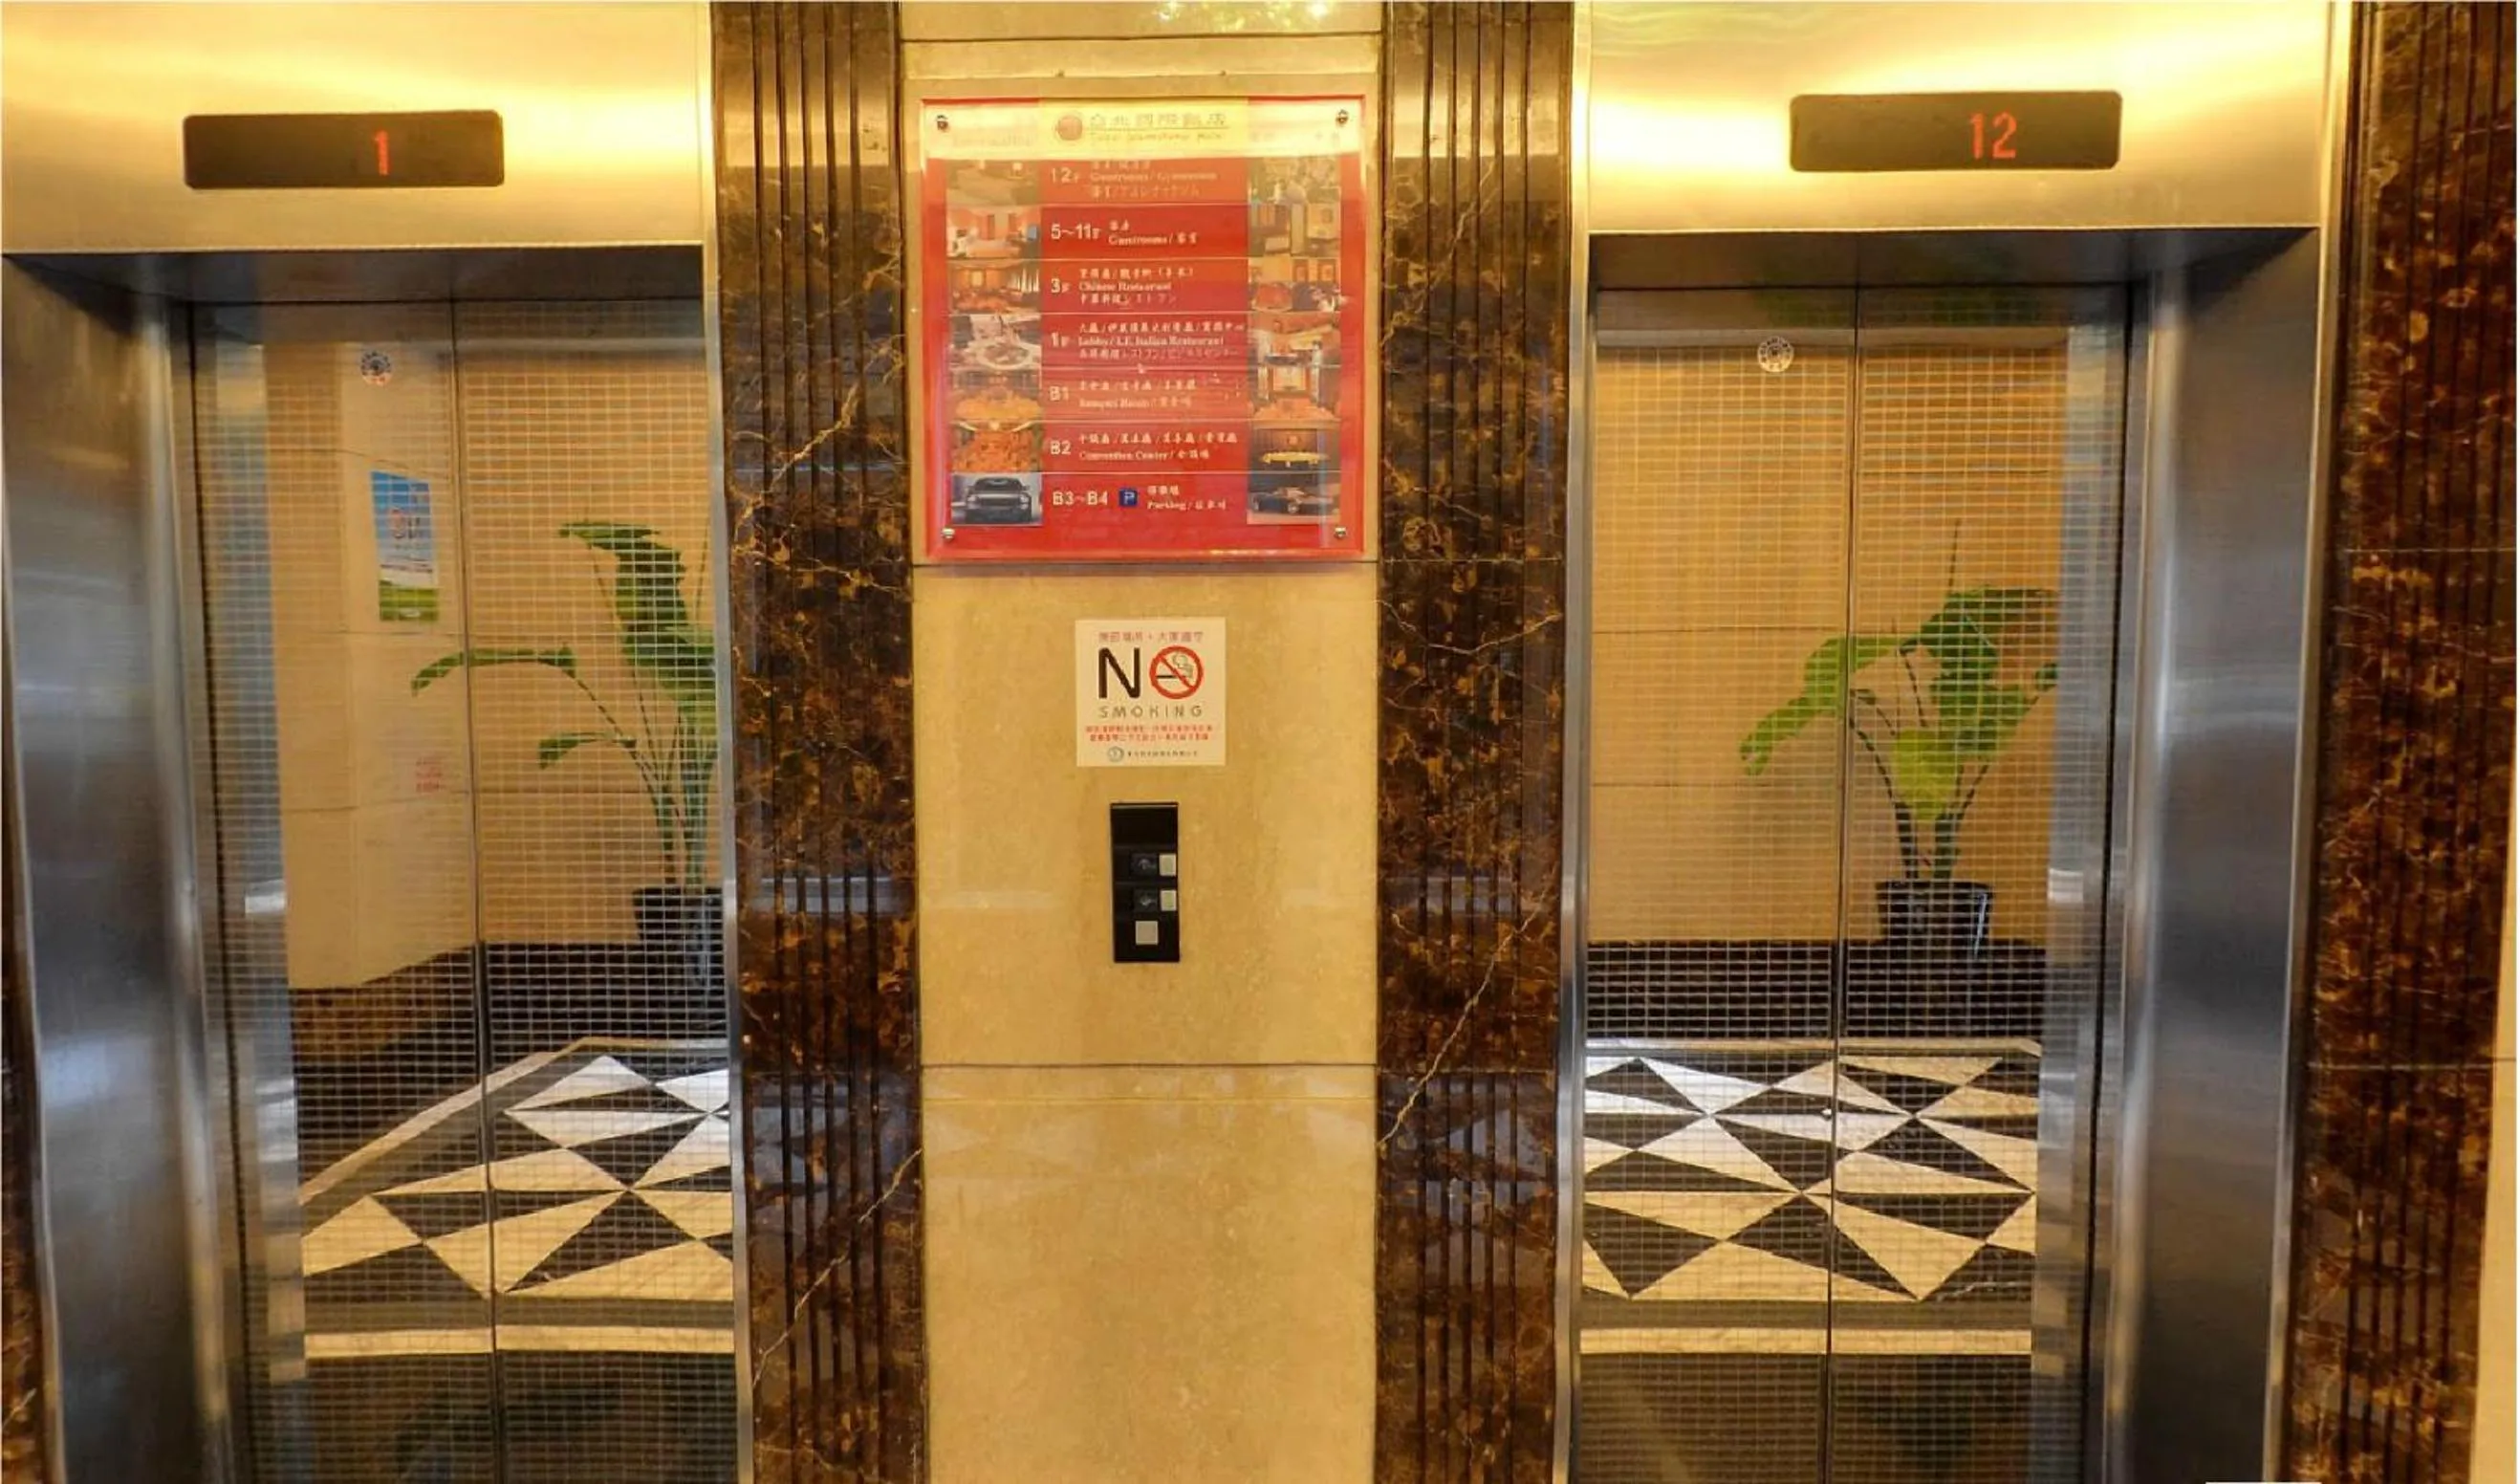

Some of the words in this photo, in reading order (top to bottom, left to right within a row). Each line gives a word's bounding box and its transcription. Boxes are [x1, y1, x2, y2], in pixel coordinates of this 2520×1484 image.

[1969, 111, 2017, 160] 12
[374, 129, 390, 176] 1
[1050, 385, 1070, 402] B1
[1050, 440, 1072, 456] B2
[1098, 705, 1203, 718] SMOKING
